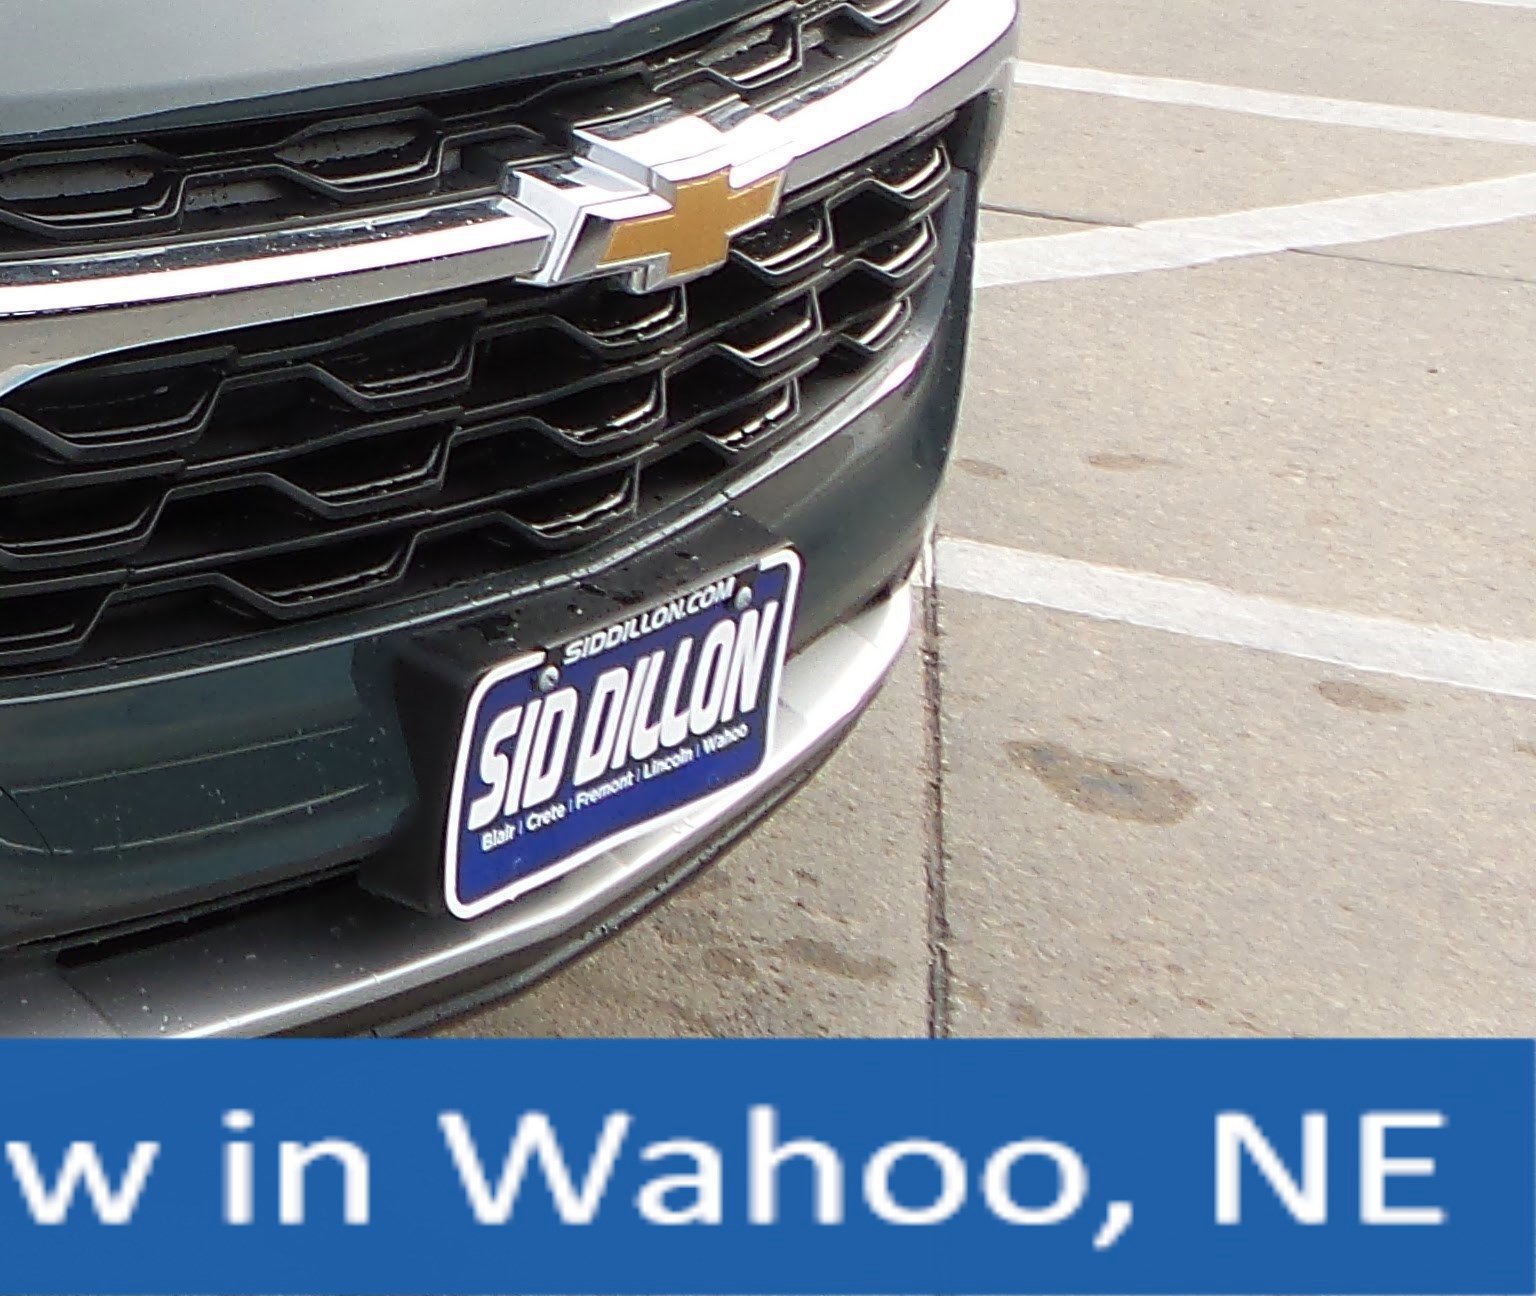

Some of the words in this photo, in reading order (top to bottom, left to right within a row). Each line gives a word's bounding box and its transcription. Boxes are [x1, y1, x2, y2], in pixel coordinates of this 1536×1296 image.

[562, 576, 736, 665] SIDDILLON.COM
[468, 686, 578, 831] SID
[572, 600, 779, 787] DILLON
[481, 822, 517, 852] Blair
[526, 803, 567, 832] Crete
[575, 770, 635, 810] Fremont
[642, 746, 694, 780] Lincoln
[702, 722, 750, 755] Wahoo
